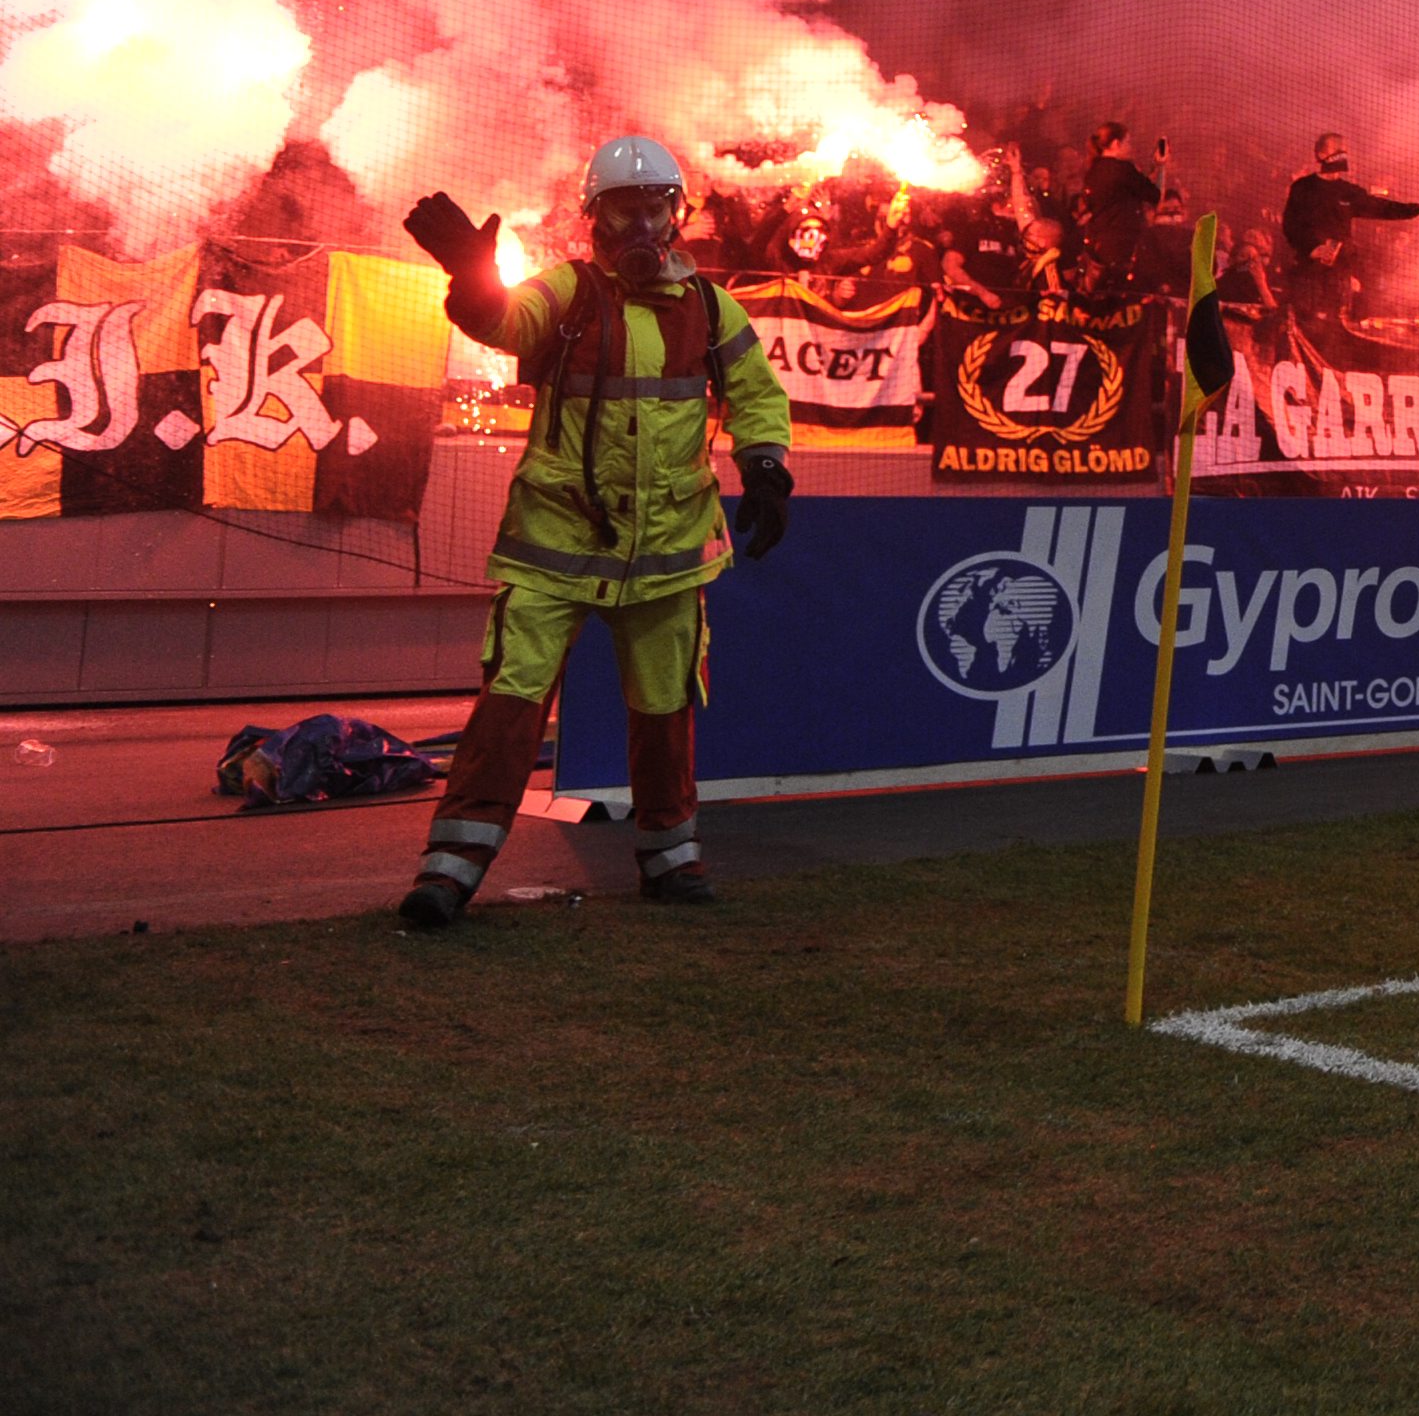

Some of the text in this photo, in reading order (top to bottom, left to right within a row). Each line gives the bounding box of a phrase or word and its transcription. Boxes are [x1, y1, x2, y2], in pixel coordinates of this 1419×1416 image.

[1003, 340, 1088, 413] 27
[939, 444, 1150, 473] ALDRIG GLÖMD
